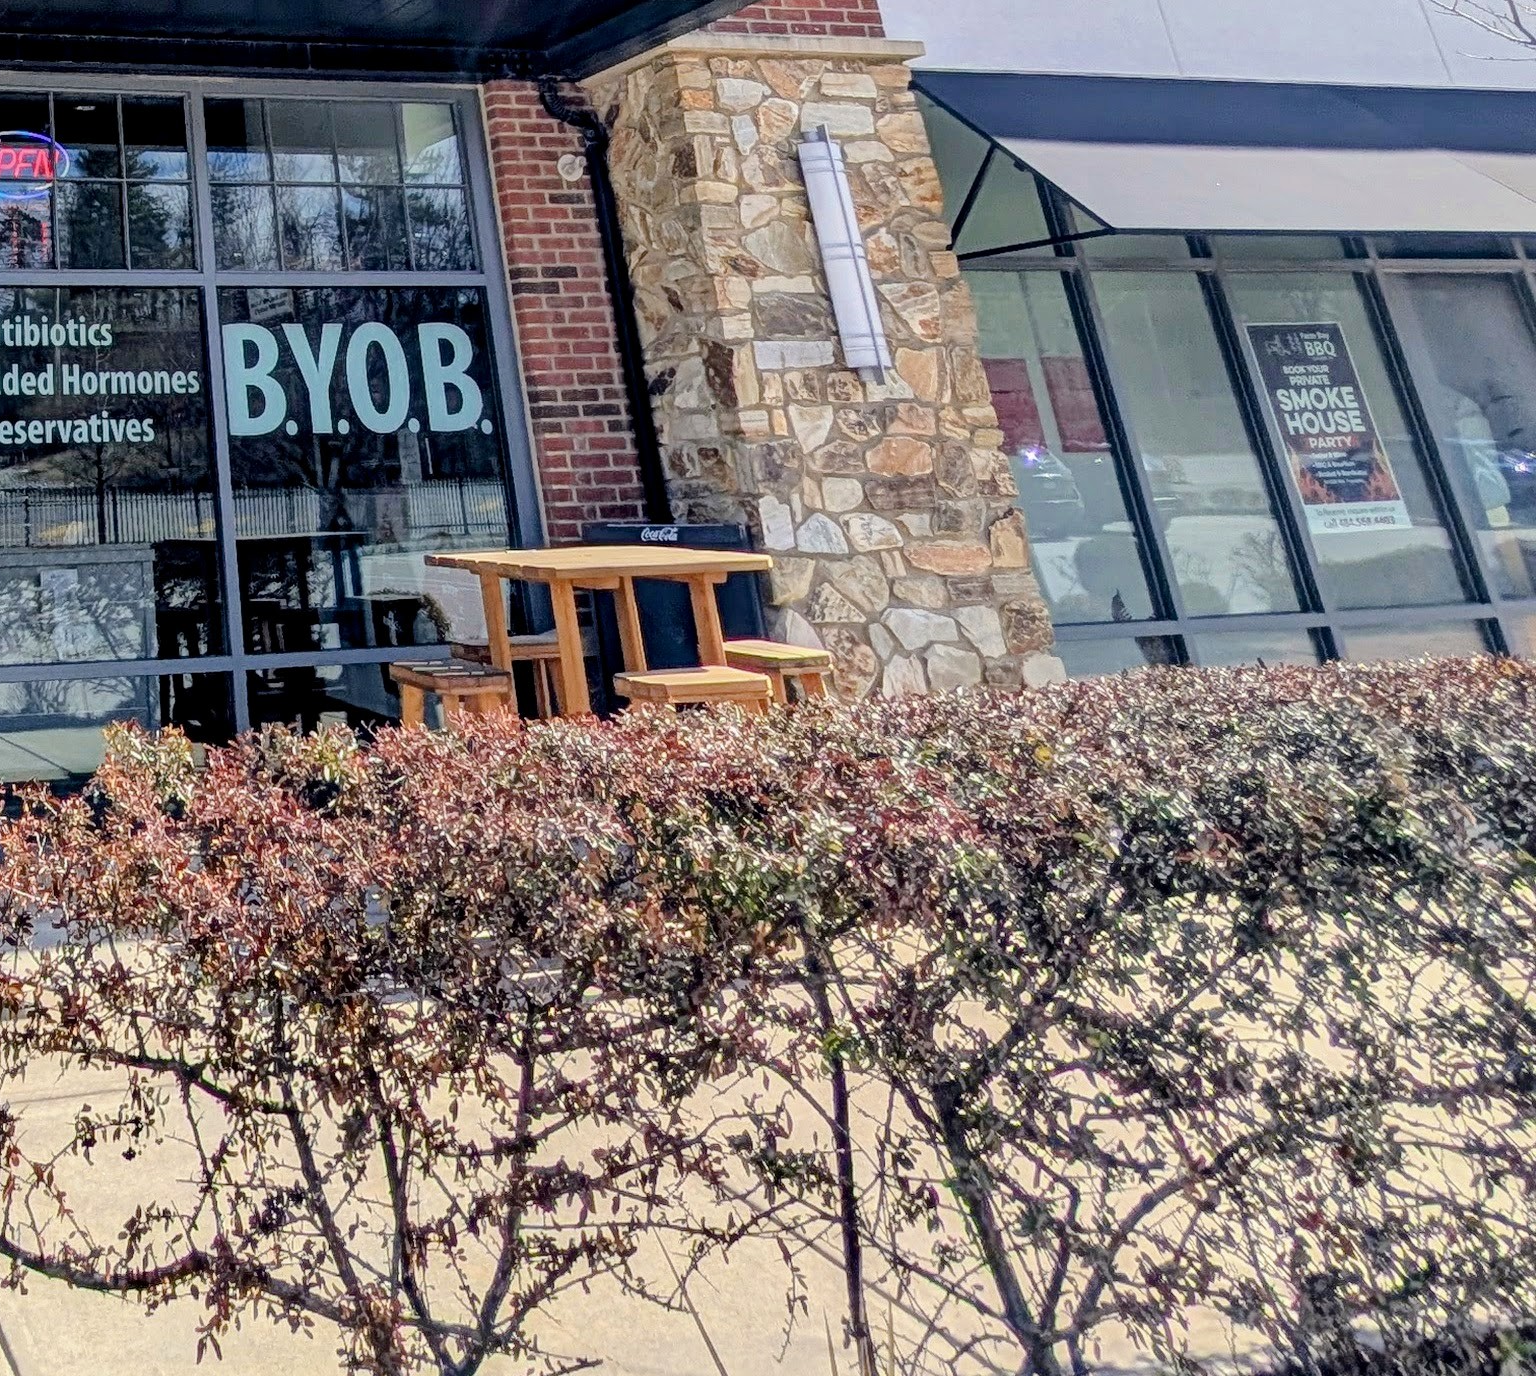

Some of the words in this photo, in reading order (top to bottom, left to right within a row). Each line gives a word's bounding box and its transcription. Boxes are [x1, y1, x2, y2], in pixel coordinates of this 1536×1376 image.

[1304, 340, 1337, 357] BBQ
[62, 364, 200, 395] Hormones
[222, 322, 493, 436] B.Y.O.B.
[1288, 375, 1331, 386] PRIVATE
[1276, 386, 1359, 411] SMOKE
[1284, 410, 1366, 435] HOUSE
[1309, 436, 1352, 448] PARTY
